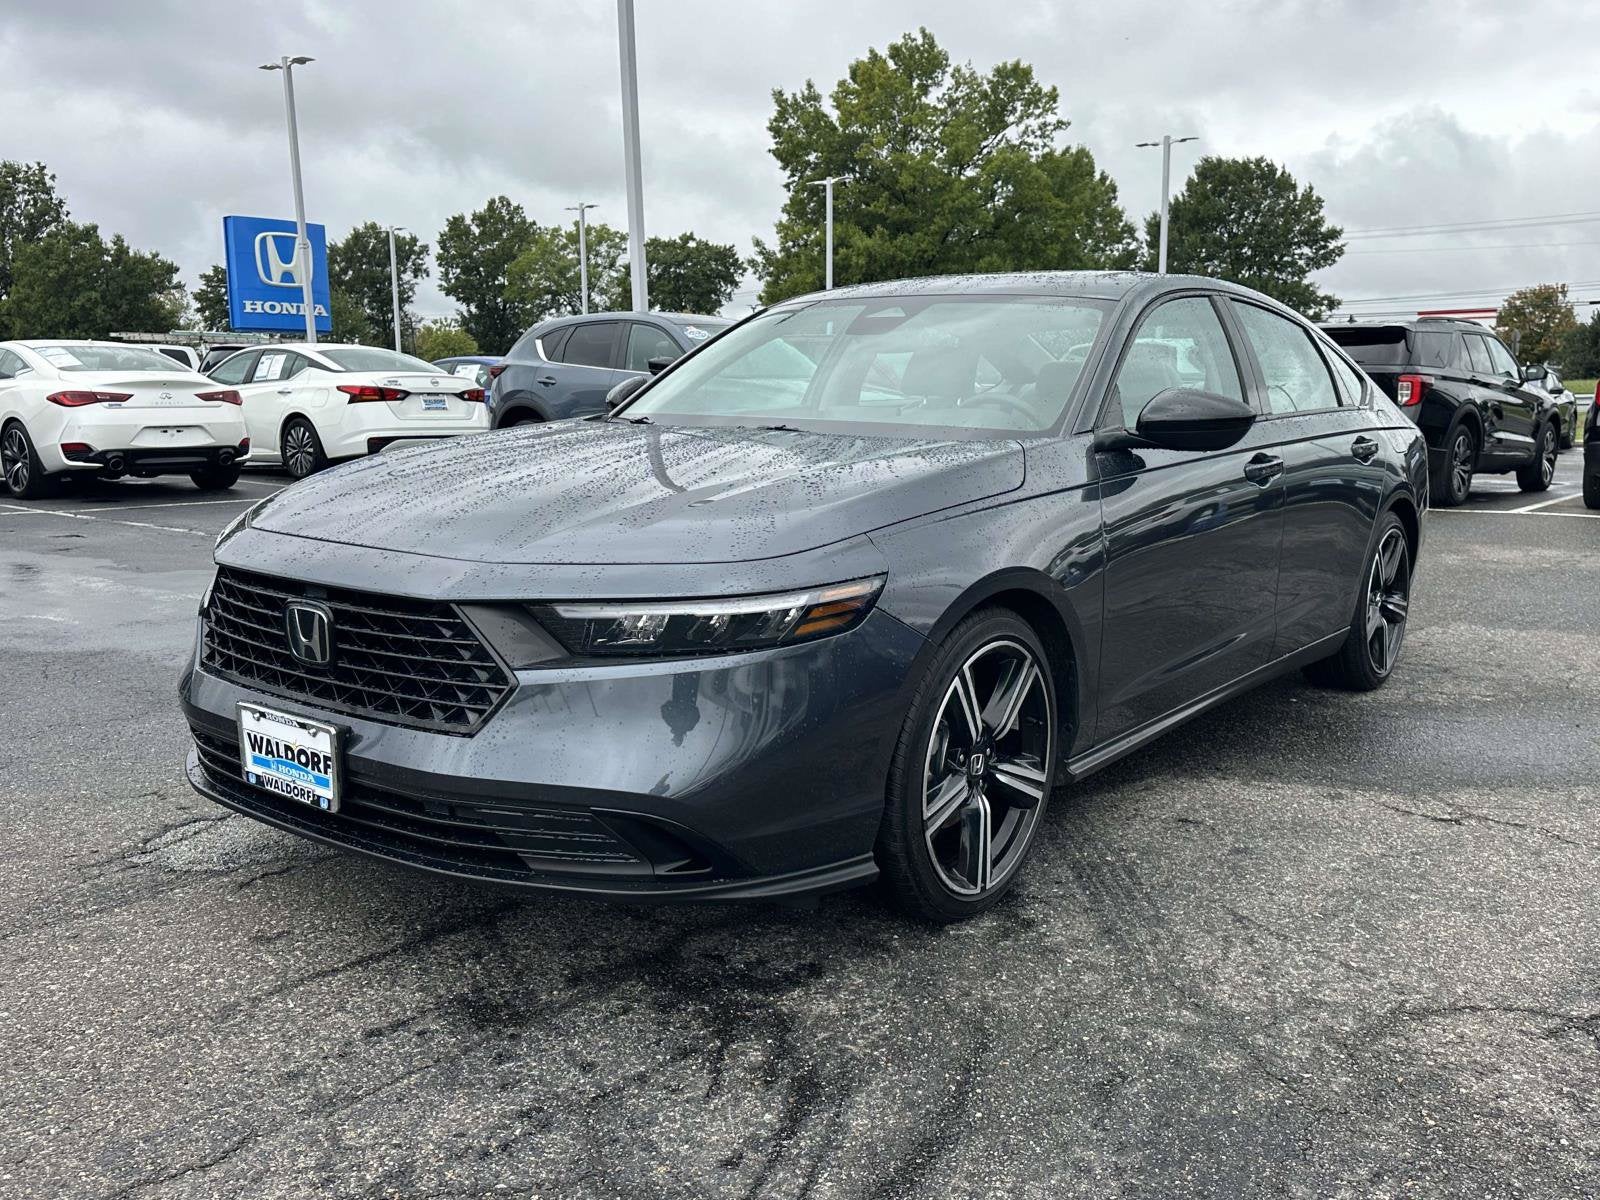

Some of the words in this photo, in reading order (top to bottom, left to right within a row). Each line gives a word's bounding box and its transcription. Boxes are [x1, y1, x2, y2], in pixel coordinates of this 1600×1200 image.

[265, 712, 300, 728] HONDA
[247, 732, 332, 775] WALDORF
[278, 764, 316, 783] HONDA
[263, 774, 312, 802] WALDORF
